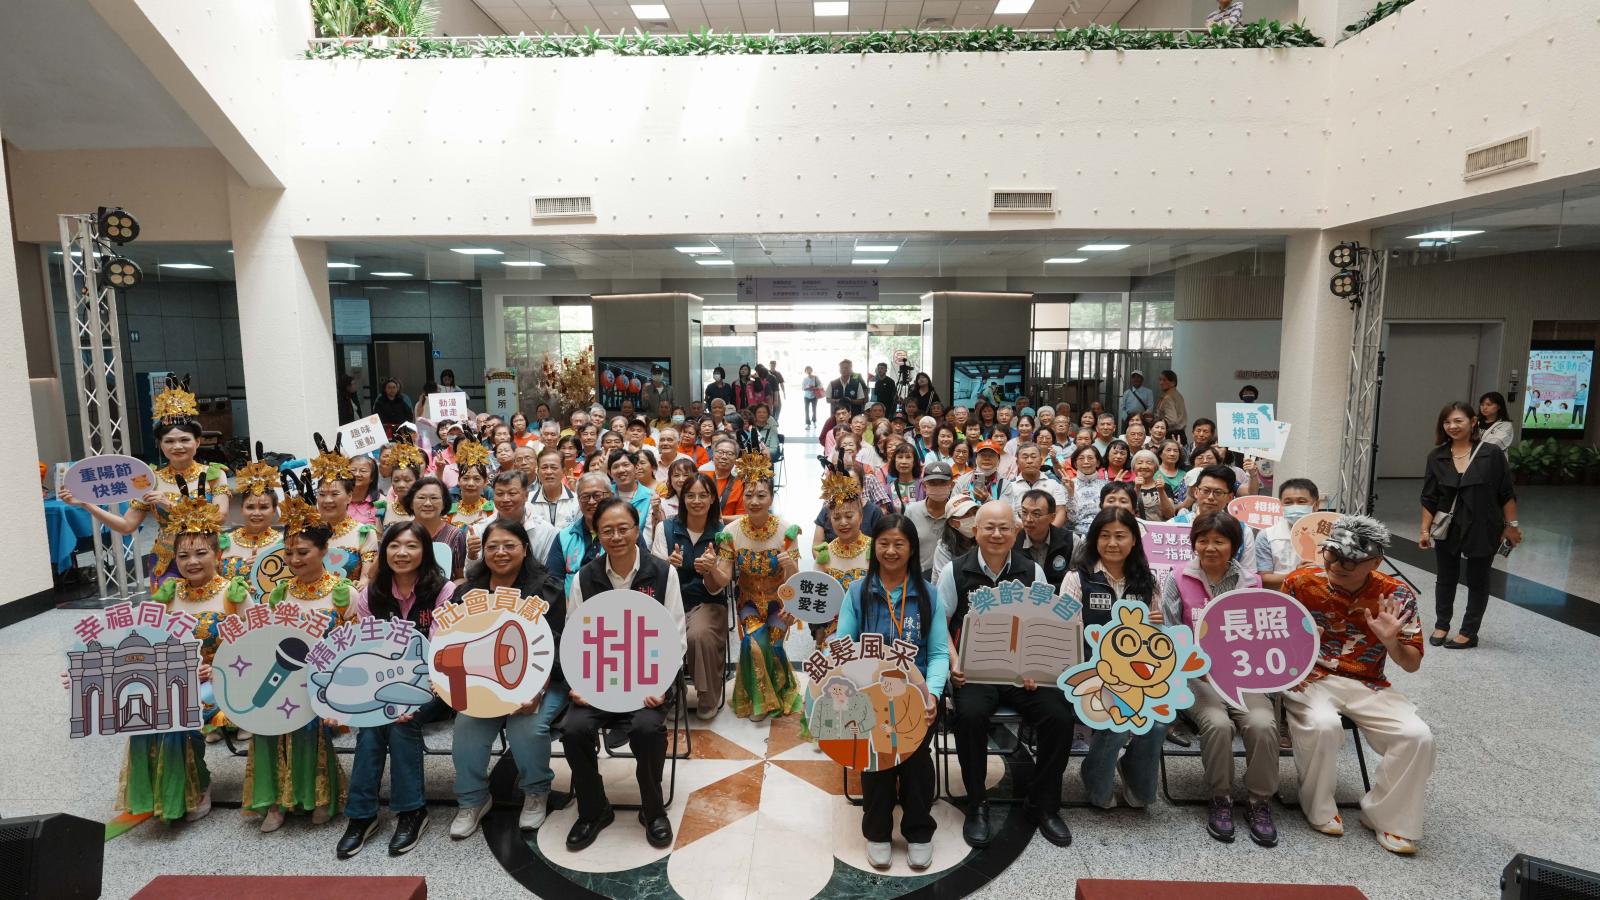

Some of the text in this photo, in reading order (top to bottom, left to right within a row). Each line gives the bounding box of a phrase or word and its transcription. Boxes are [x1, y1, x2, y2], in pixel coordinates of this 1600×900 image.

[1232, 412, 1259, 425] 樂高
[350, 424, 371, 439] 趣味
[354, 436, 376, 450] 運動
[1233, 427, 1260, 440] 桃園
[79, 463, 133, 483] 重陽節
[92, 481, 128, 498] 快樂
[800, 580, 829, 597] 敬老
[969, 580, 1083, 621] 樂齡學習
[433, 588, 549, 630] 社會貢獻
[798, 597, 827, 614] 愛老
[73, 602, 198, 642] 幸福同行
[217, 604, 331, 644] 健康樂活
[1219, 606, 1290, 642] 長照
[305, 616, 415, 671] 精彩生活
[803, 634, 918, 683] 銀髮風采
[1231, 647, 1287, 677] 3.0
